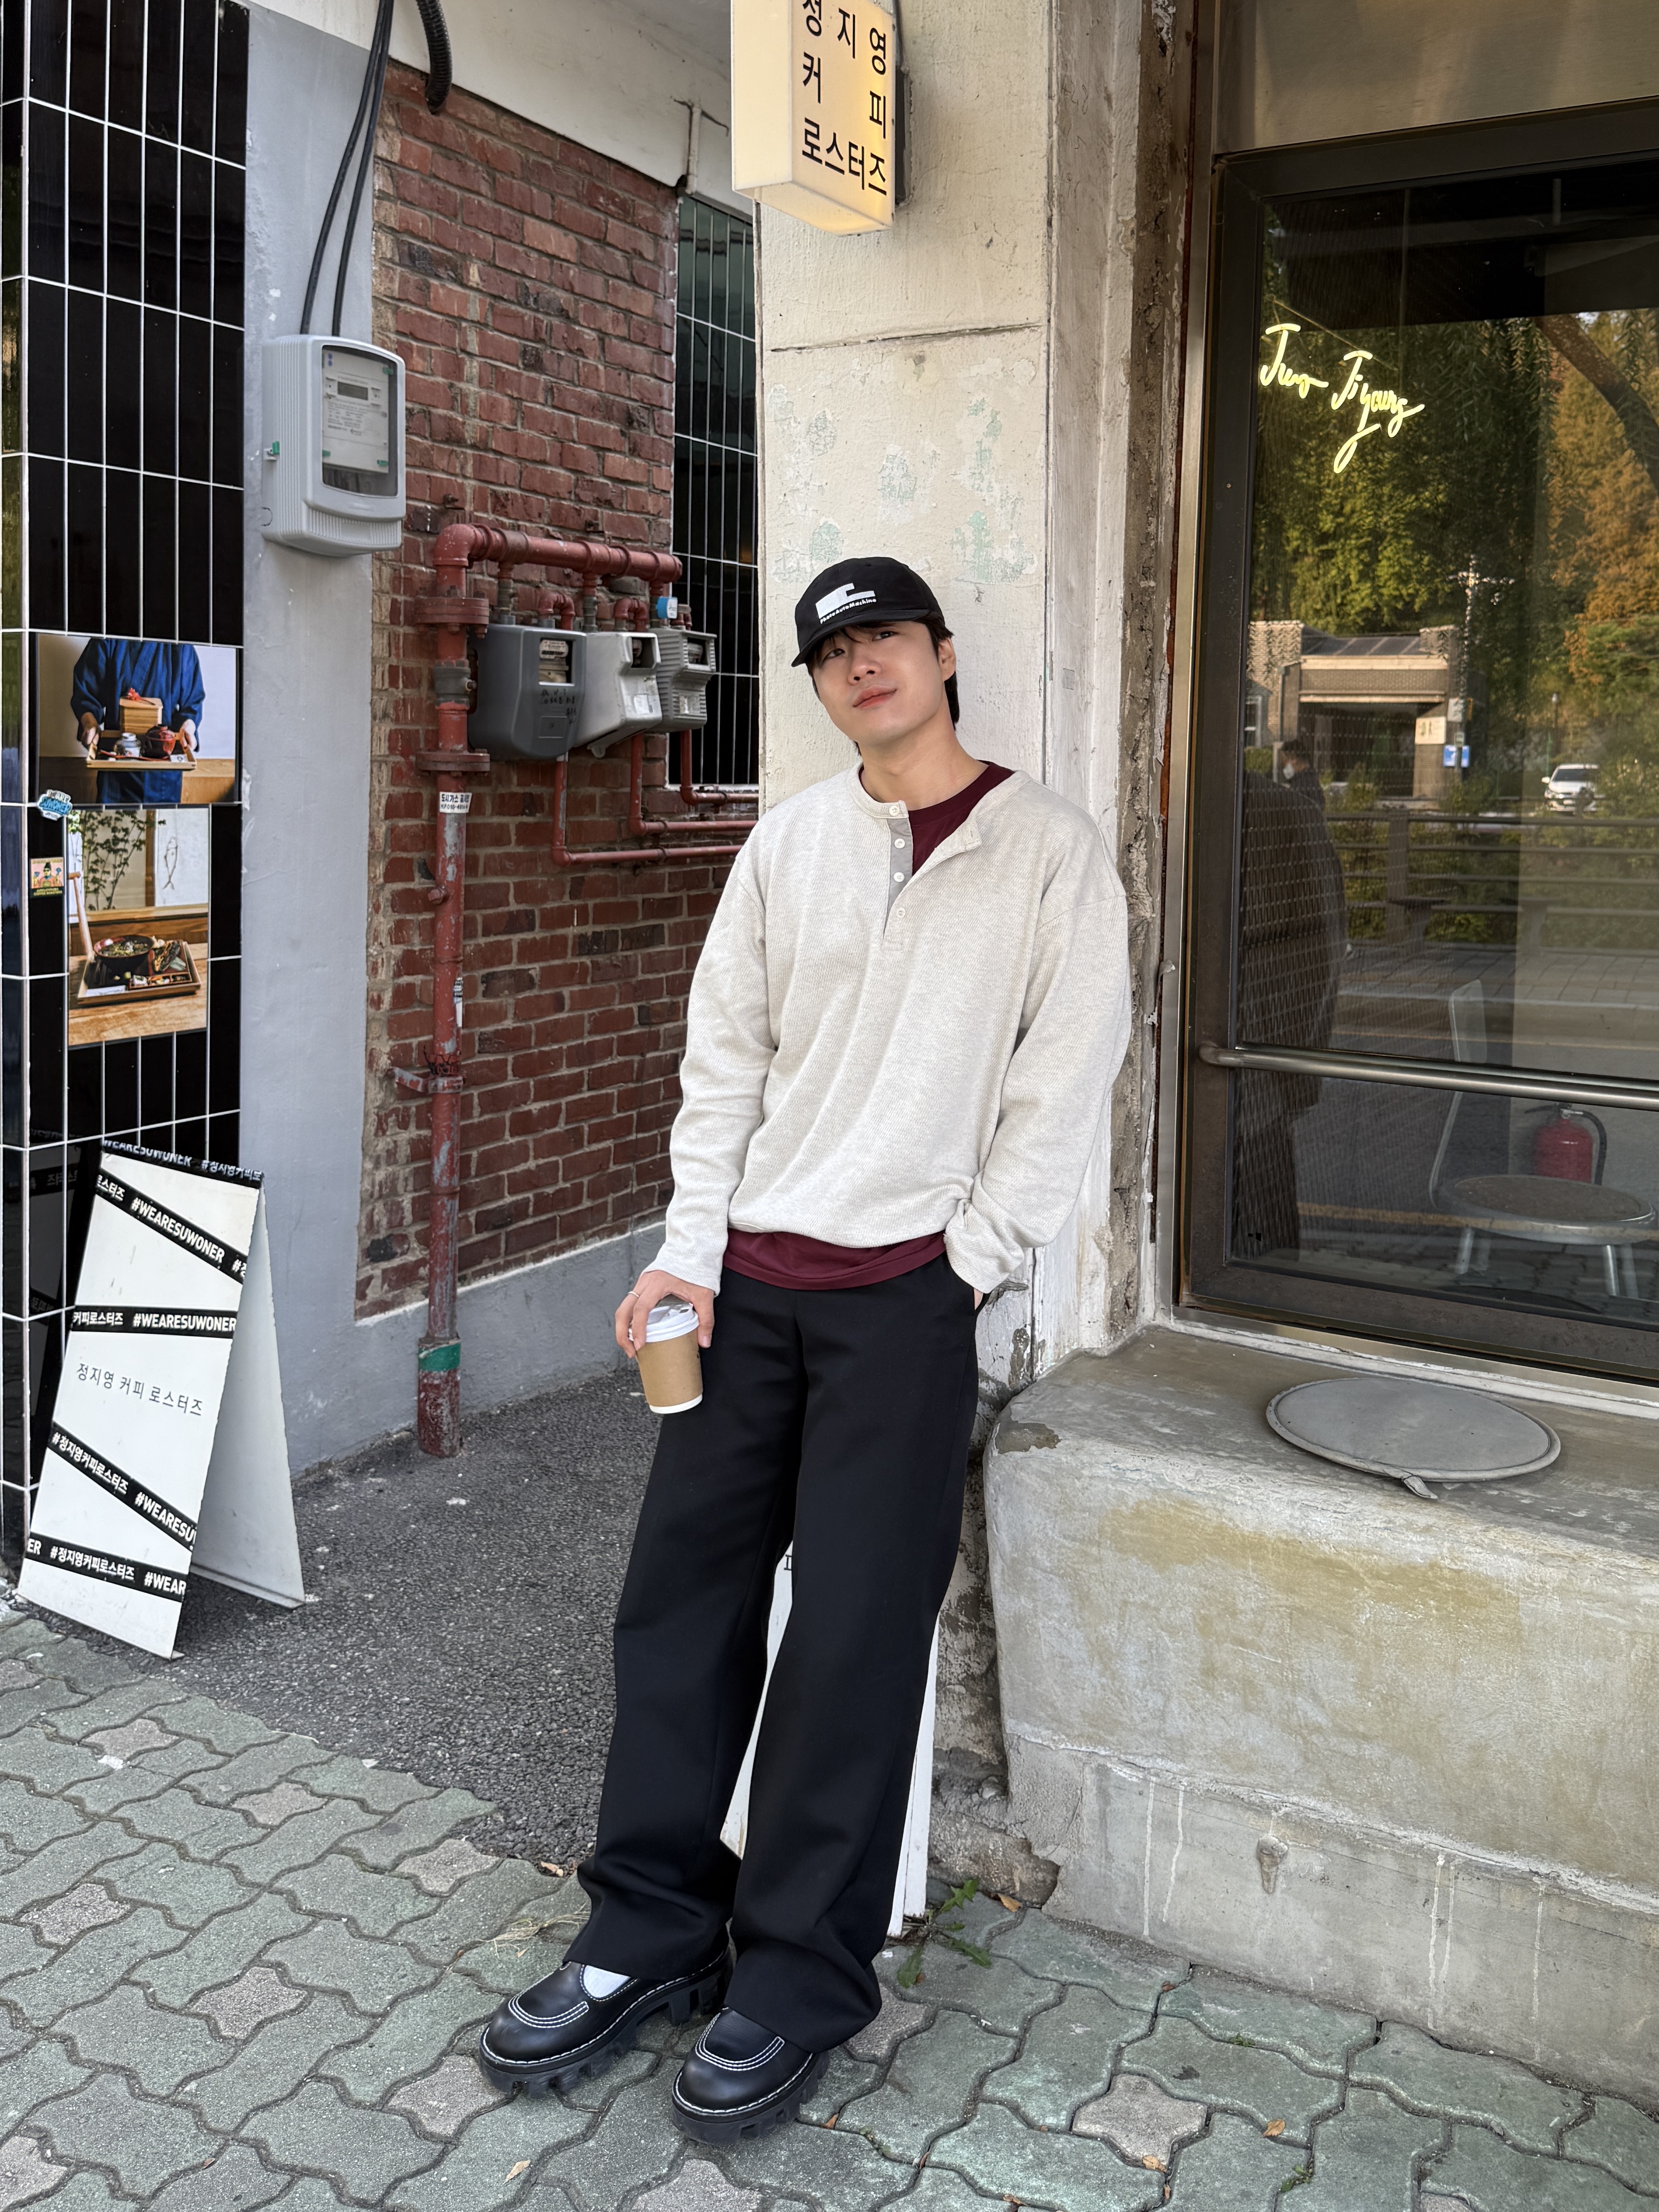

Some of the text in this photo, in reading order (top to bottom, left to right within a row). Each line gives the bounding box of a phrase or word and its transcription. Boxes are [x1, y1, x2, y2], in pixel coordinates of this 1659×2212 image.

[803, 51, 886, 139] 커피
[802, 117, 887, 196] 로스터즈
[131, 1197, 225, 1263] #WEARESUWONER
[132, 1313, 237, 1332] #WEARESUWONER
[76, 1363, 203, 1416] 정지영 커피 로스터즈
[52, 1432, 197, 1544] #정지영커피로스터즈 #WEARESU
[50, 1546, 135, 1580] #정지영커피로스터즈
